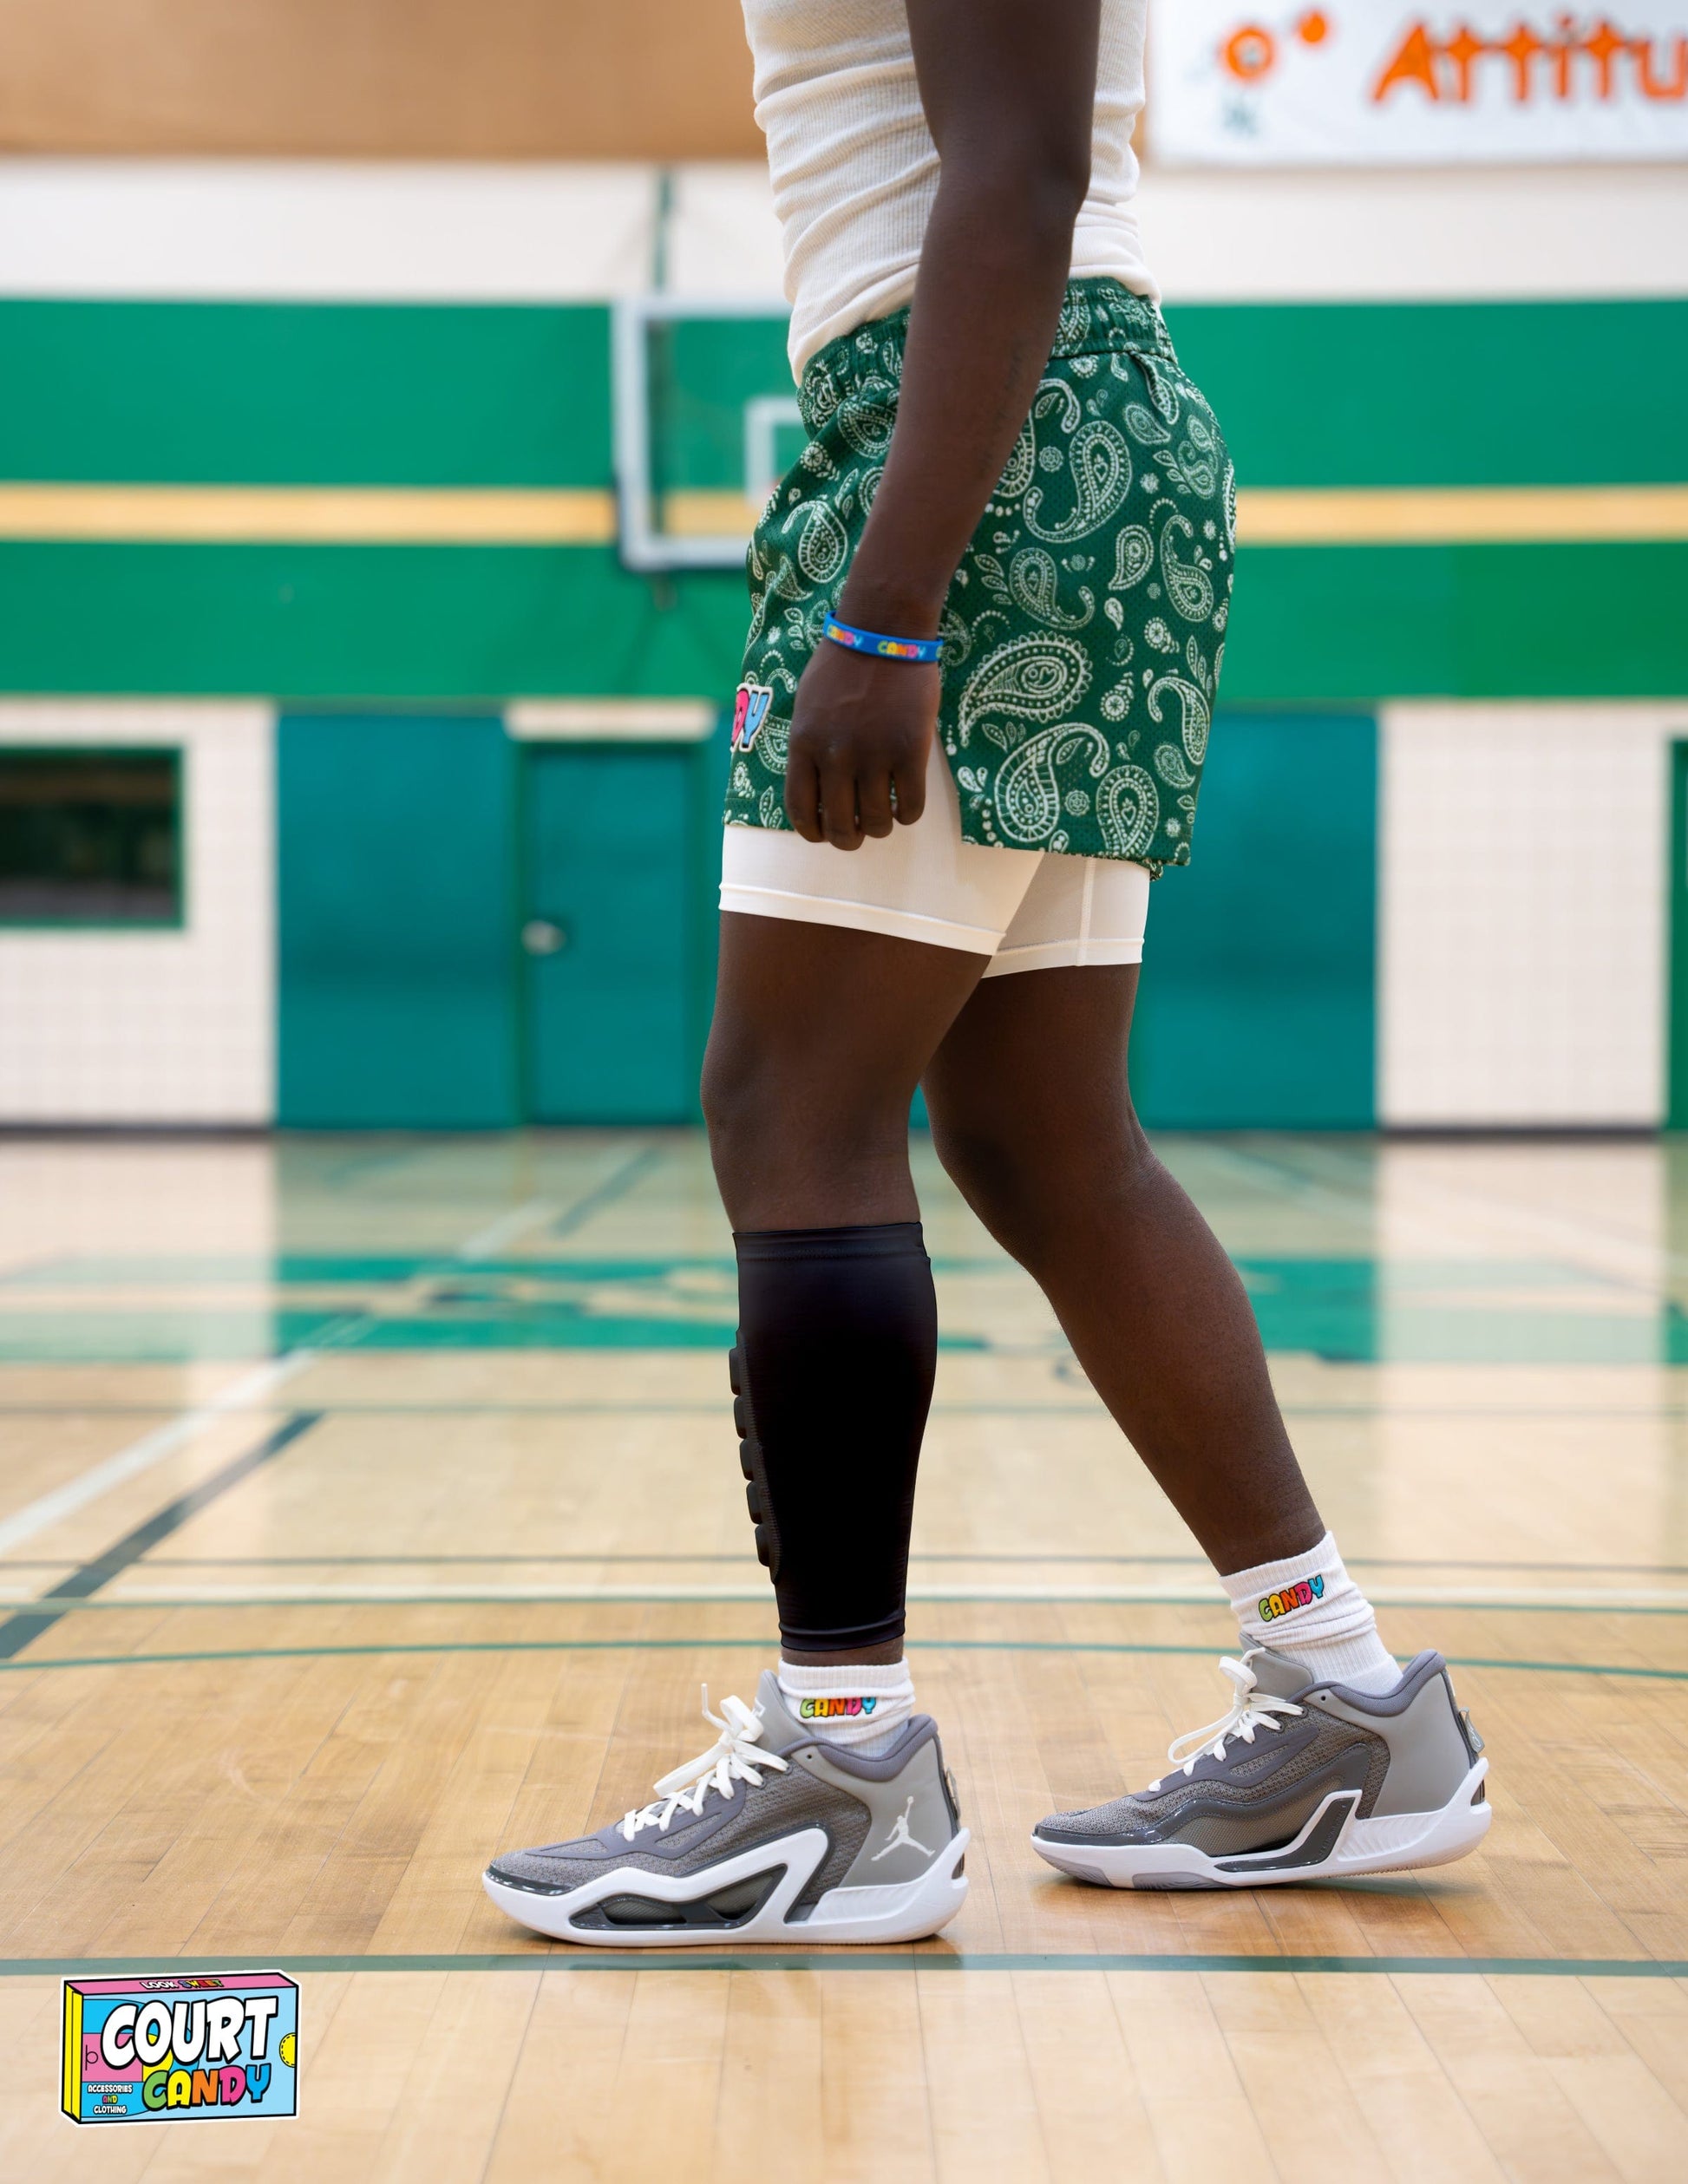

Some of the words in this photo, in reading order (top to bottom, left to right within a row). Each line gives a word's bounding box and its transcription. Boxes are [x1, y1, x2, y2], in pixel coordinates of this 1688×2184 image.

[877, 640, 926, 659] CANDY
[1258, 1573, 1325, 1623] CANDY
[799, 1697, 877, 1718] CANDY
